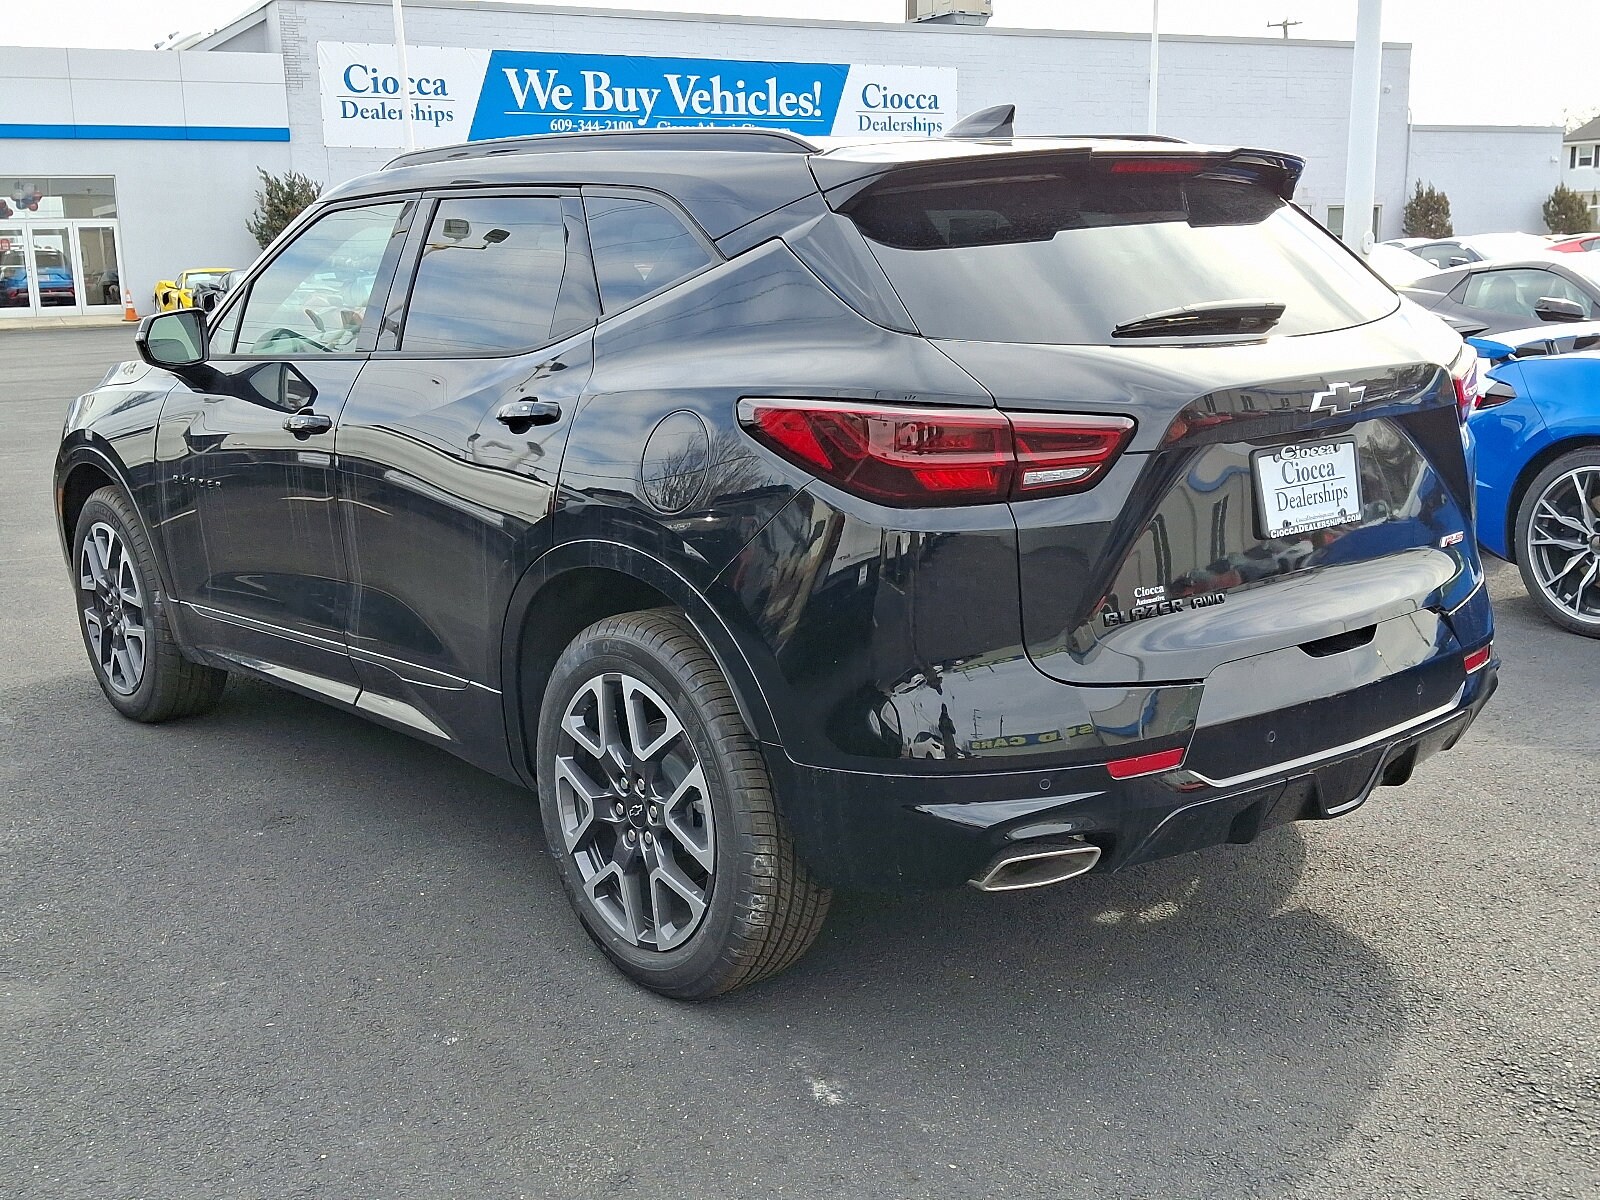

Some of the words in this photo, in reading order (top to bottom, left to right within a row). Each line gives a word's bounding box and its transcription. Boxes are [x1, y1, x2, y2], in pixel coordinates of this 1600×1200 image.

[502, 67, 573, 112] We
[580, 70, 661, 126] Buy
[664, 73, 823, 117] Vehicles!
[862, 83, 939, 110] Ciocca
[550, 119, 633, 132] 609-344-2100
[858, 115, 943, 136] Dealerships
[1280, 444, 1335, 460] Ciocca
[1281, 461, 1335, 485] Ciocca
[1275, 482, 1348, 512] Dealerships
[1270, 513, 1361, 539] CIOCCADEALERSHIPS.COM
[1440, 530, 1464, 548] RS
[1133, 585, 1165, 598] Ciocca
[1102, 599, 1184, 627] BLAZER
[1190, 592, 1226, 610] AWD
